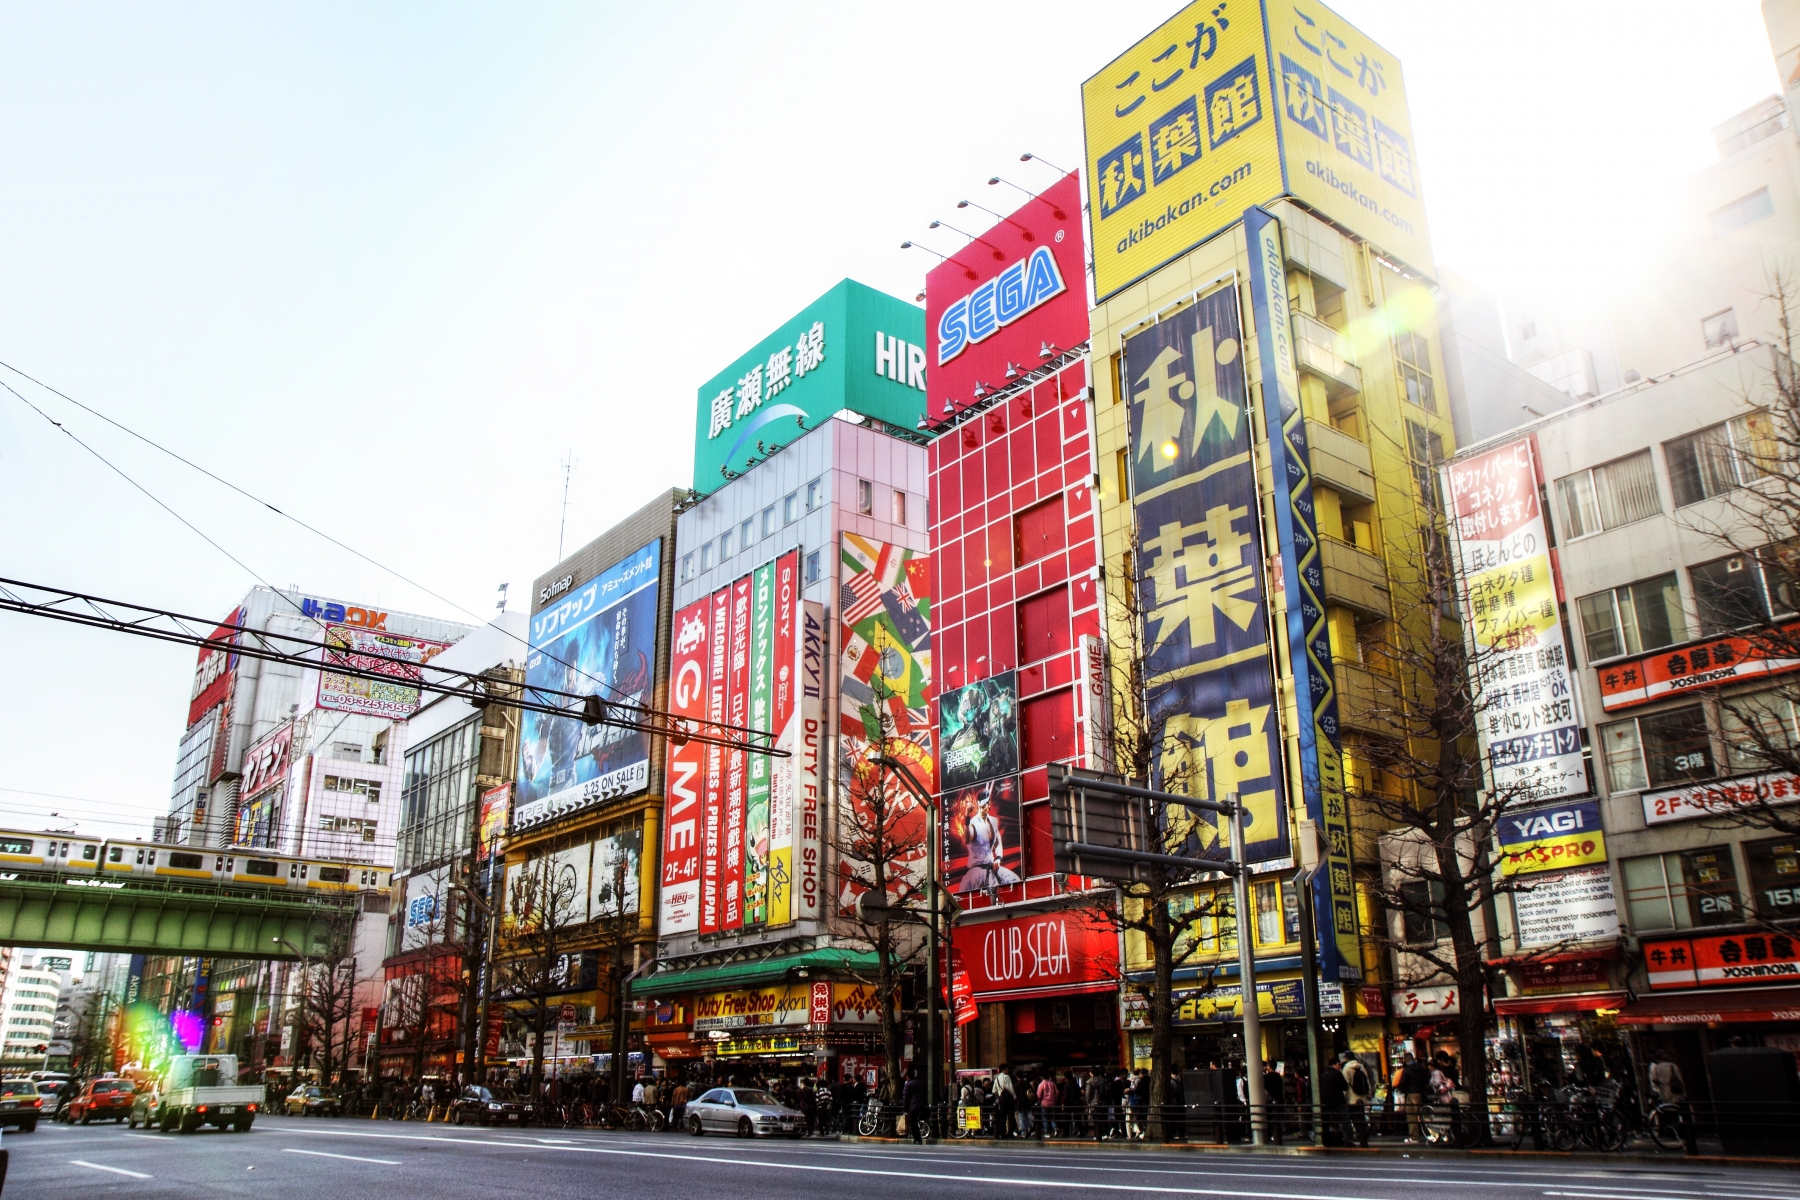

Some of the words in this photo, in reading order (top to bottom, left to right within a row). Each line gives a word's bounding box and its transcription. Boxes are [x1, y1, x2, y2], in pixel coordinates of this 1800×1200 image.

[1115, 2, 1230, 118] ここが
[1293, 5, 1387, 97] ここが
[1100, 72, 1259, 218] 秋葉館
[1283, 70, 1414, 197] 秋葉館
[1116, 162, 1252, 254] akibakan.com
[1306, 158, 1414, 236] akibakan.com
[938, 245, 1067, 367] SEGA
[1265, 238, 1291, 377] akibakan.com
[875, 331, 927, 392] HIR
[1454, 444, 1529, 496] 光ファイバーに
[1470, 476, 1518, 508] コネクタ
[1471, 532, 1537, 571] ほとんどの
[535, 583, 597, 640] ソフマップ
[601, 556, 653, 596] アミューズメント館
[540, 574, 573, 604] Sofmap
[780, 567, 791, 638] SONY
[1134, 325, 1279, 855] 秋葉館
[755, 568, 769, 692] メロンブックス
[1477, 598, 1554, 636] ファイバー種
[713, 606, 726, 680] WELCOME!
[804, 611, 821, 685] AKKY
[1091, 644, 1105, 697] GAME
[1551, 678, 1568, 699] OK
[1605, 668, 1637, 689] 牛丼
[1669, 667, 1737, 690] YOSHINOYA
[709, 739, 721, 788] AMES
[804, 718, 818, 777] DUTY
[583, 780, 599, 797] 3.25
[601, 777, 614, 791] ON
[616, 767, 635, 786] SALE
[708, 791, 718, 803] &
[525, 803, 543, 817] PS3
[803, 784, 817, 840] FREE
[1512, 809, 1584, 837] YAGI
[706, 806, 718, 856] PRIZES
[706, 860, 716, 876] IN
[1508, 840, 1596, 865] MASPRO
[803, 848, 817, 908] SHOP
[1532, 892, 1547, 900] fiber
[1548, 890, 1560, 898] and
[1561, 888, 1589, 898] polishing
[1590, 884, 1610, 893] shape
[671, 892, 688, 905] Hey
[705, 879, 716, 926] JAPAN
[1517, 902, 1546, 911] Japanese
[1519, 910, 1535, 918] quick
[1536, 907, 1558, 917] delivery
[1520, 917, 1549, 926] Welcoming
[1550, 913, 1579, 923] connector
[1581, 908, 1618, 920] replacement
[1528, 924, 1561, 935] repolishing
[1562, 922, 1575, 931] only
[984, 926, 1024, 982] CLUB
[1027, 920, 1071, 979] SEGA
[1651, 947, 1688, 966] 牛丼
[1722, 963, 1799, 978] YOSHINOYA
[127, 975, 140, 1005] AKIBA
[697, 996, 722, 1017] Duty
[722, 993, 746, 1015] Free
[748, 990, 775, 1013] Shop
[813, 983, 828, 1022] 免税店
[1663, 1014, 1722, 1024] YOSHINOYA
